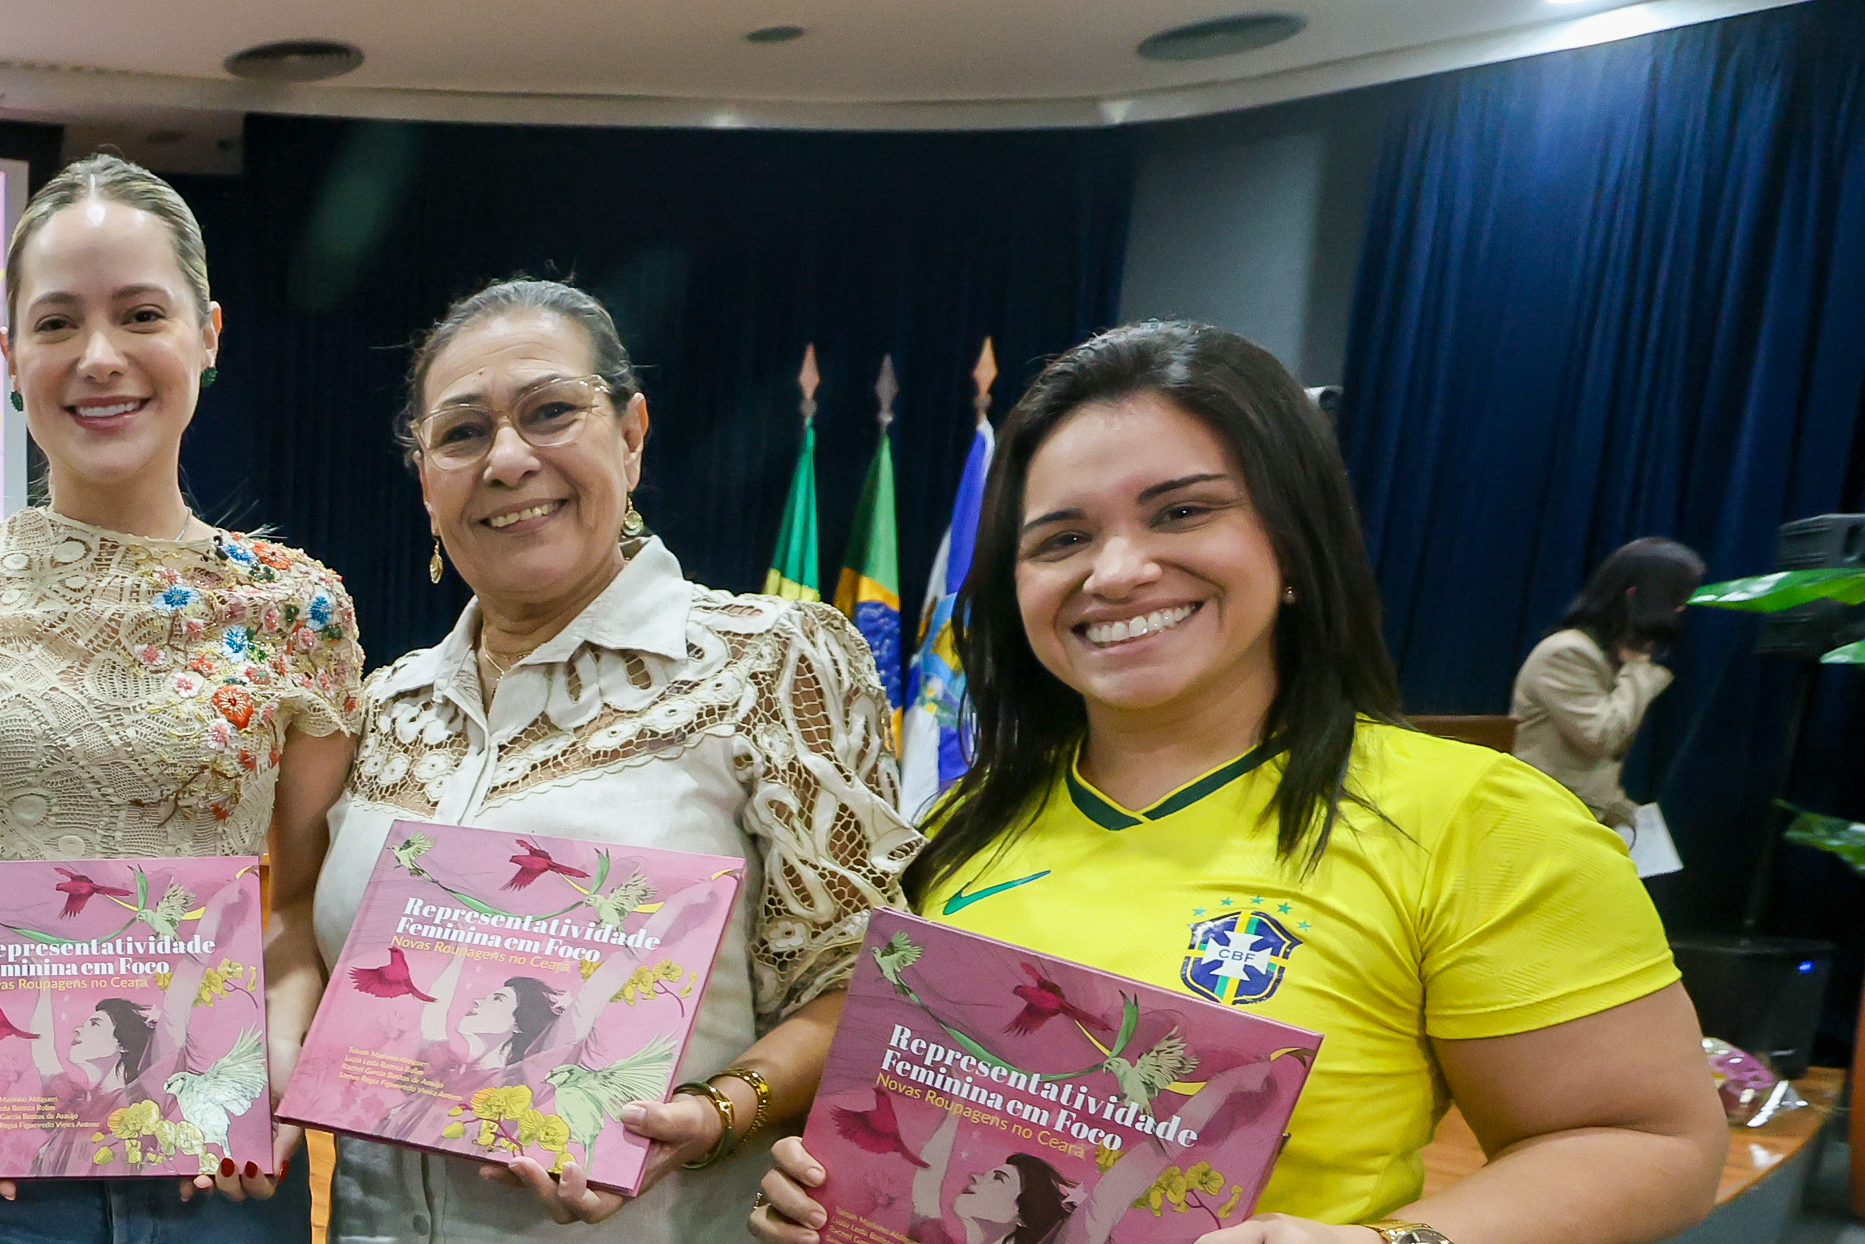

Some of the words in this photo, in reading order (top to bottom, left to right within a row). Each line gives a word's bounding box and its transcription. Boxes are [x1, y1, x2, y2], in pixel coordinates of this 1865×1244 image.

[395, 916, 503, 948] Feminina
[504, 934, 542, 953] em
[543, 937, 601, 963] Foco
[403, 897, 662, 952] Representatividade
[80, 961, 115, 975] em
[118, 957, 170, 975] Foco
[390, 935, 431, 951] Novas
[434, 941, 506, 963] Roupagens
[509, 954, 528, 965] no
[530, 957, 571, 972] Ceará
[1218, 948, 1257, 963] CBF
[18, 978, 87, 992] Roupagens
[91, 978, 108, 988] no
[875, 1072, 922, 1100] Novas
[924, 1091, 1009, 1131] Roupagens
[1011, 1122, 1033, 1140] no
[880, 1048, 1003, 1111] Feminina
[1004, 1097, 1050, 1127] em
[1052, 1107, 1123, 1151] Foco
[888, 1023, 1199, 1149] Representatividade
